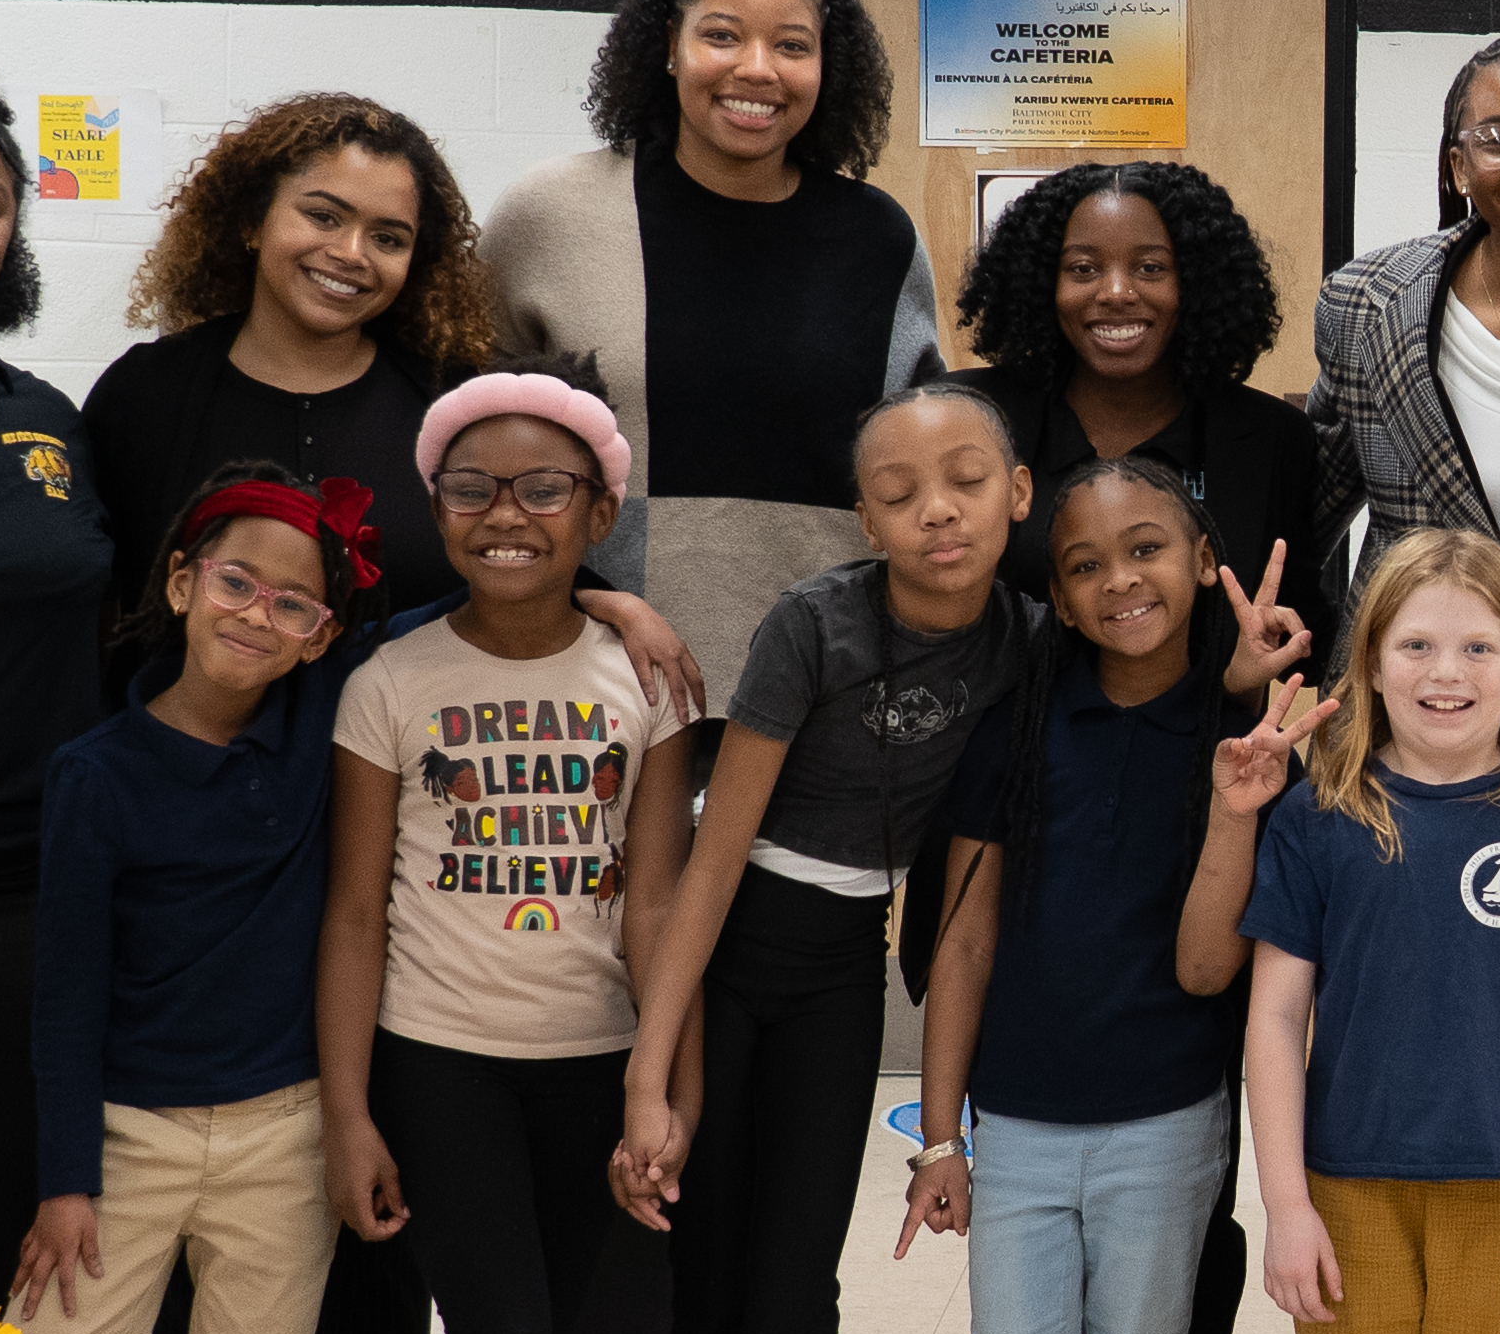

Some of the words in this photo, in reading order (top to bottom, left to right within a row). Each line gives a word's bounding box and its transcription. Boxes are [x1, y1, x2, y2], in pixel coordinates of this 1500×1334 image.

[1102, 2, 1117, 16] في
[1120, 3, 1137, 14] بكم
[996, 23, 1110, 39] WELCOME
[990, 49, 1114, 65] CAFETERIA
[935, 75, 1000, 84] BIENVENUE
[1003, 72, 1012, 84] À
[1013, 75, 1029, 85] LA
[1030, 73, 1094, 85] CAFÉTÉRIA
[1014, 96, 1058, 105] KARIBU
[1061, 96, 1109, 106] KWENYE
[1111, 97, 1175, 107] CAFETERIA
[52, 128, 107, 142] SHARE
[955, 128, 989, 136] Baltimore
[989, 128, 1004, 137] City
[1005, 128, 1028, 136] Public
[1028, 128, 1056, 136] Schools
[54, 148, 105, 162] TABLE
[440, 700, 608, 747] DREAM
[483, 753, 591, 796] LEAD
